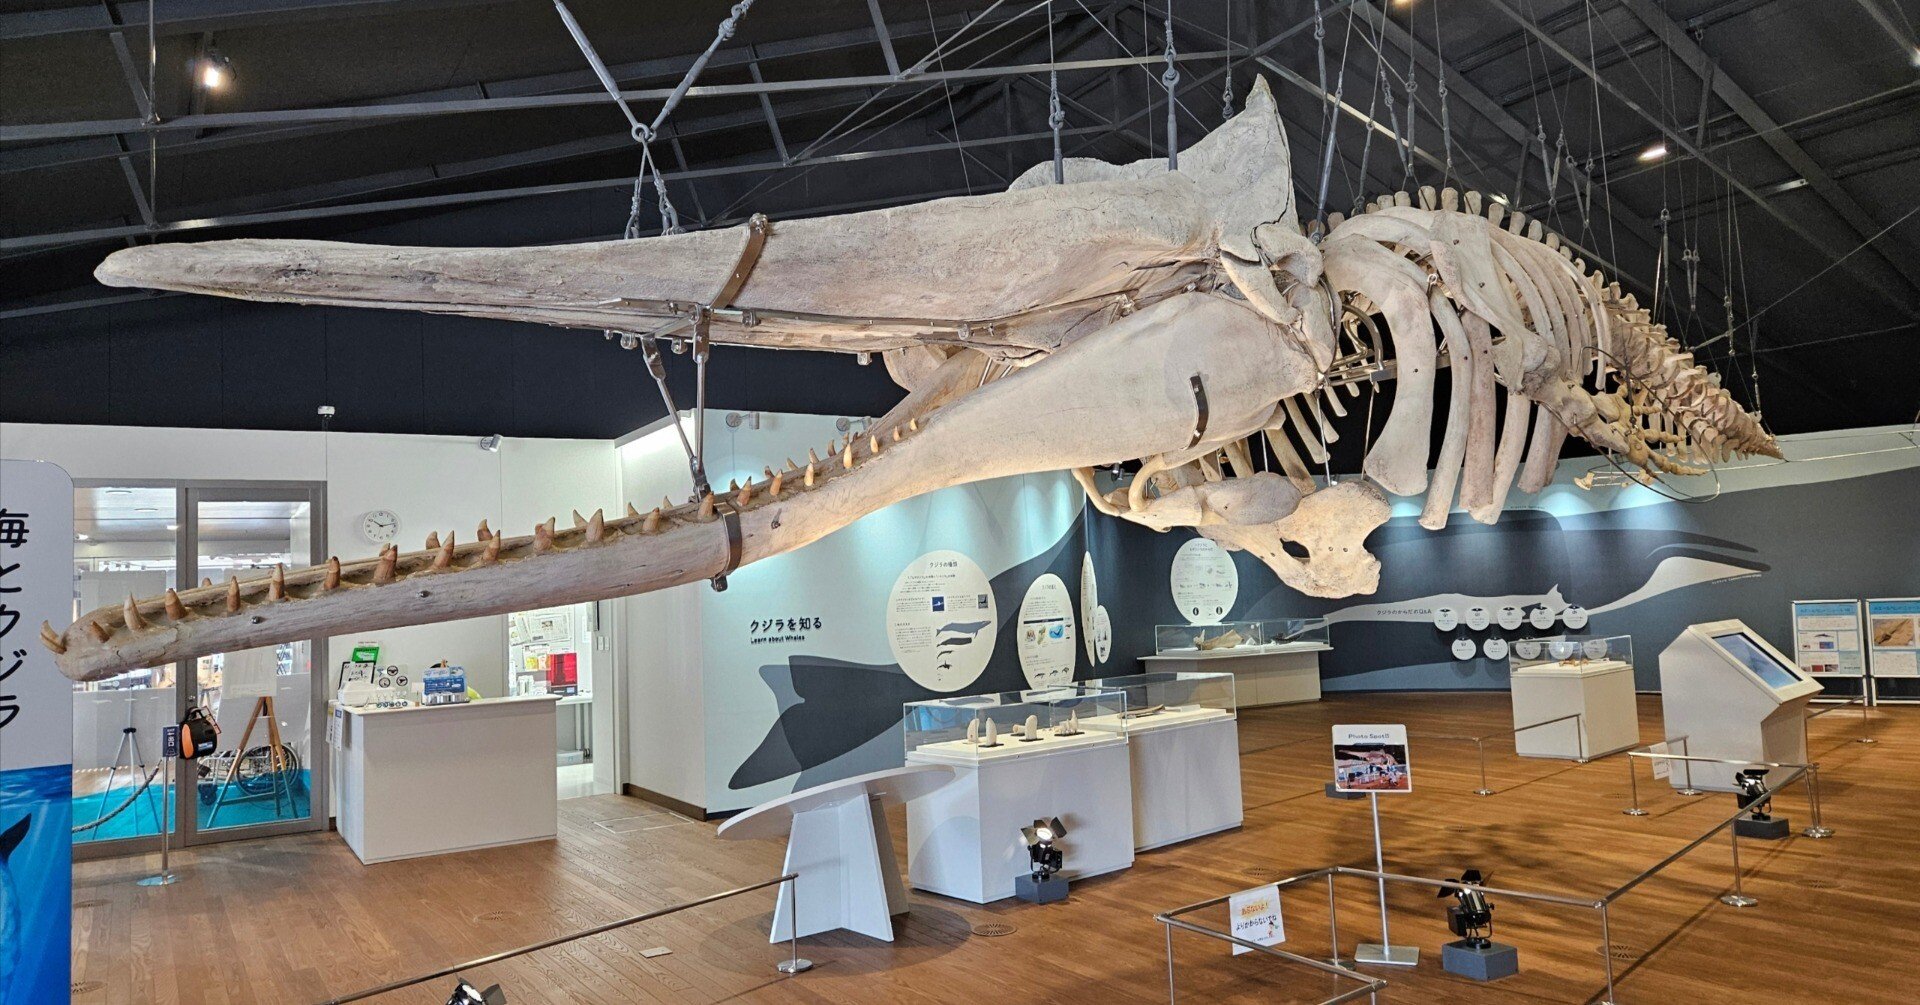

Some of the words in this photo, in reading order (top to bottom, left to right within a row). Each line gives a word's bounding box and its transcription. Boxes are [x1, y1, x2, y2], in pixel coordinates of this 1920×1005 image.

[750, 616, 822, 634] クジラを知る
[750, 636, 767, 644] Learn
[768, 635, 784, 643] about
[785, 634, 805, 642] Whales
